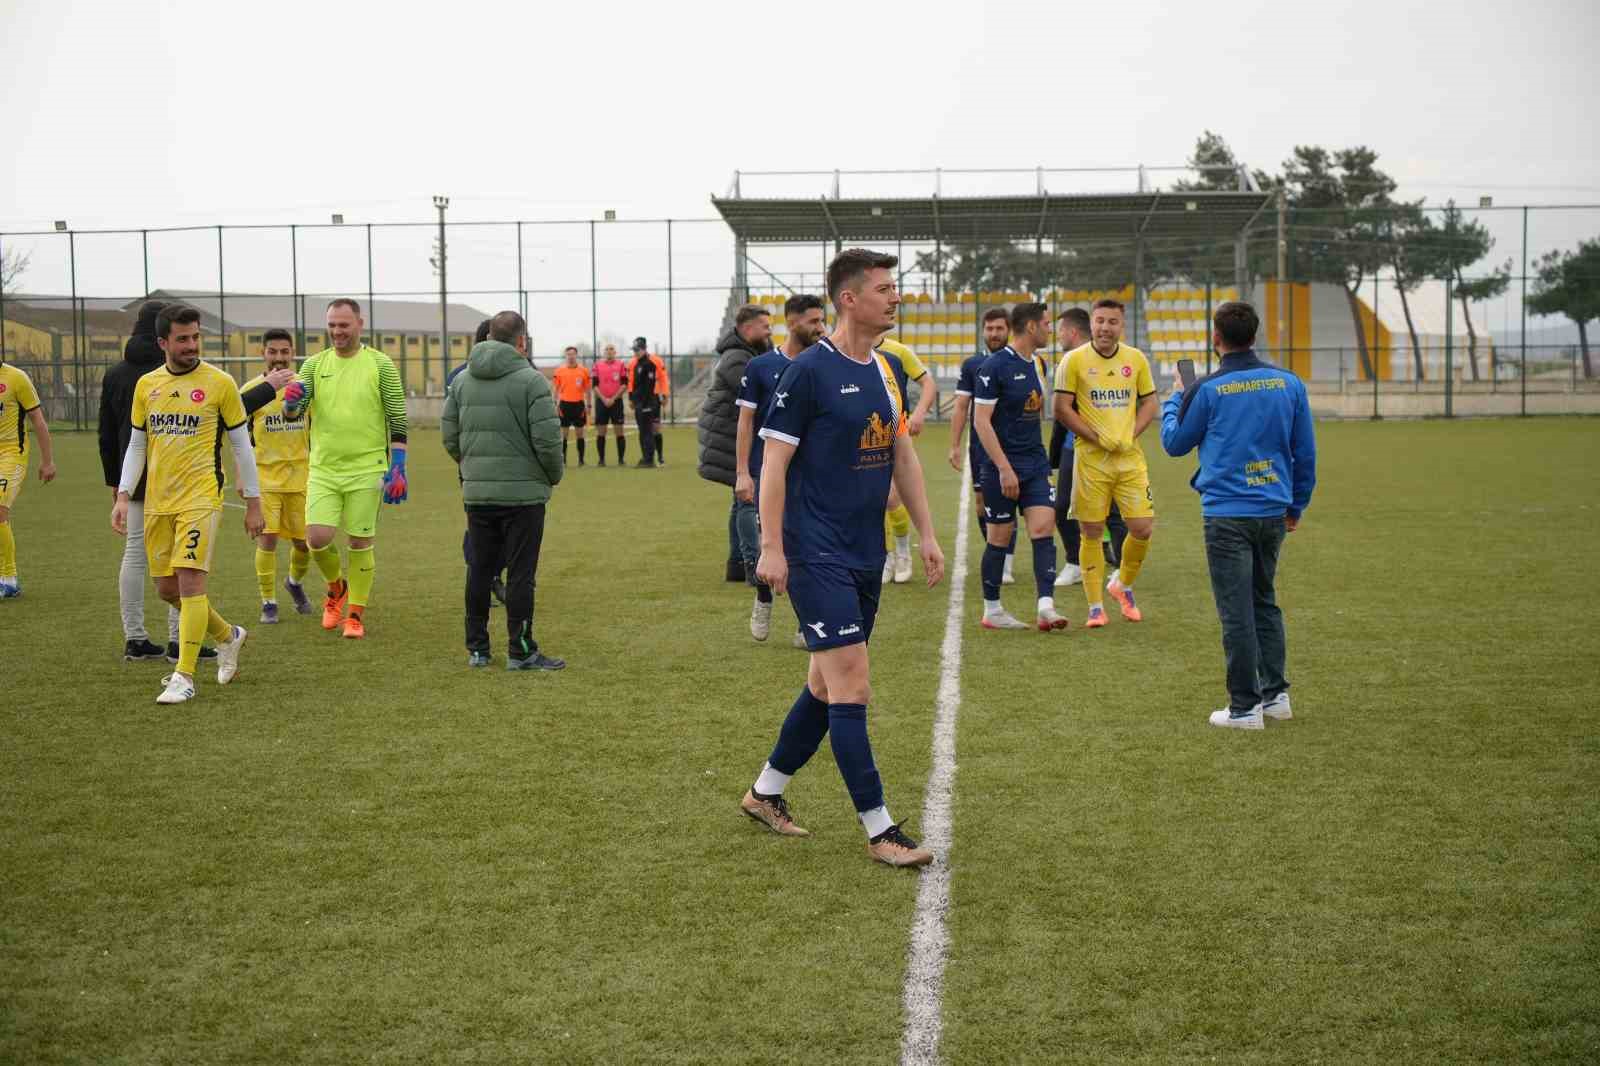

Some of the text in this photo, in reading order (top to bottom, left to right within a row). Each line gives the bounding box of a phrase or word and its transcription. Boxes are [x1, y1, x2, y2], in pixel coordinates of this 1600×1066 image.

[1090, 389, 1131, 401] AKALIN
[149, 413, 200, 428] AKALIN
[186, 529, 201, 549] 3
